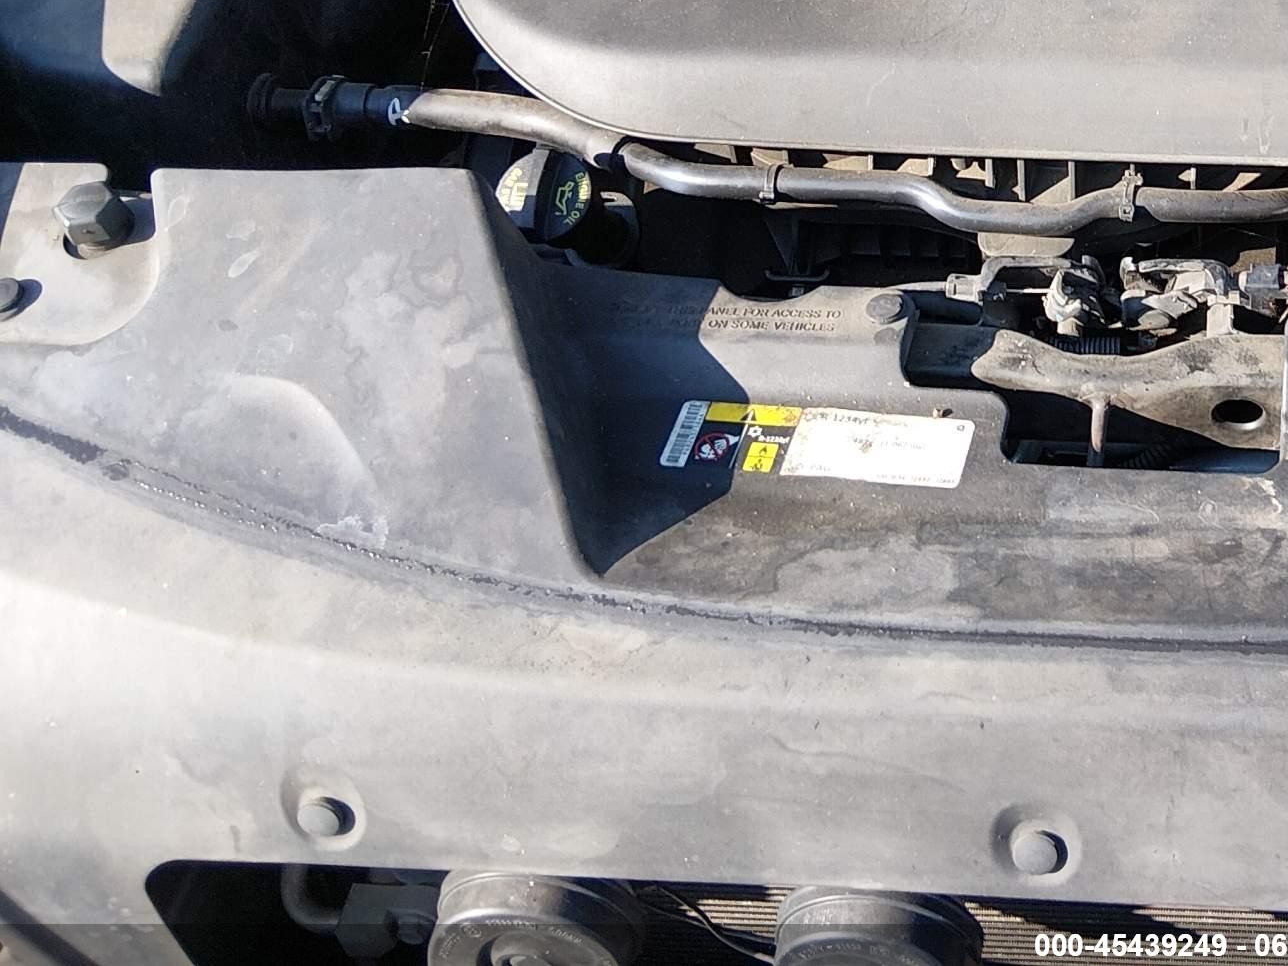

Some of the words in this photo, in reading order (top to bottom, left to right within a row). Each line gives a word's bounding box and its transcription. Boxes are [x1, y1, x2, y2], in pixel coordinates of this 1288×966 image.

[575, 171, 590, 209] ENGINE
[563, 210, 580, 225] OIL
[743, 307, 769, 318] FOR
[771, 308, 822, 318] ACCESS
[825, 309, 841, 319] TO
[708, 319, 728, 329] ON
[731, 320, 769, 330] SOME
[774, 321, 836, 331] VEHICLES
